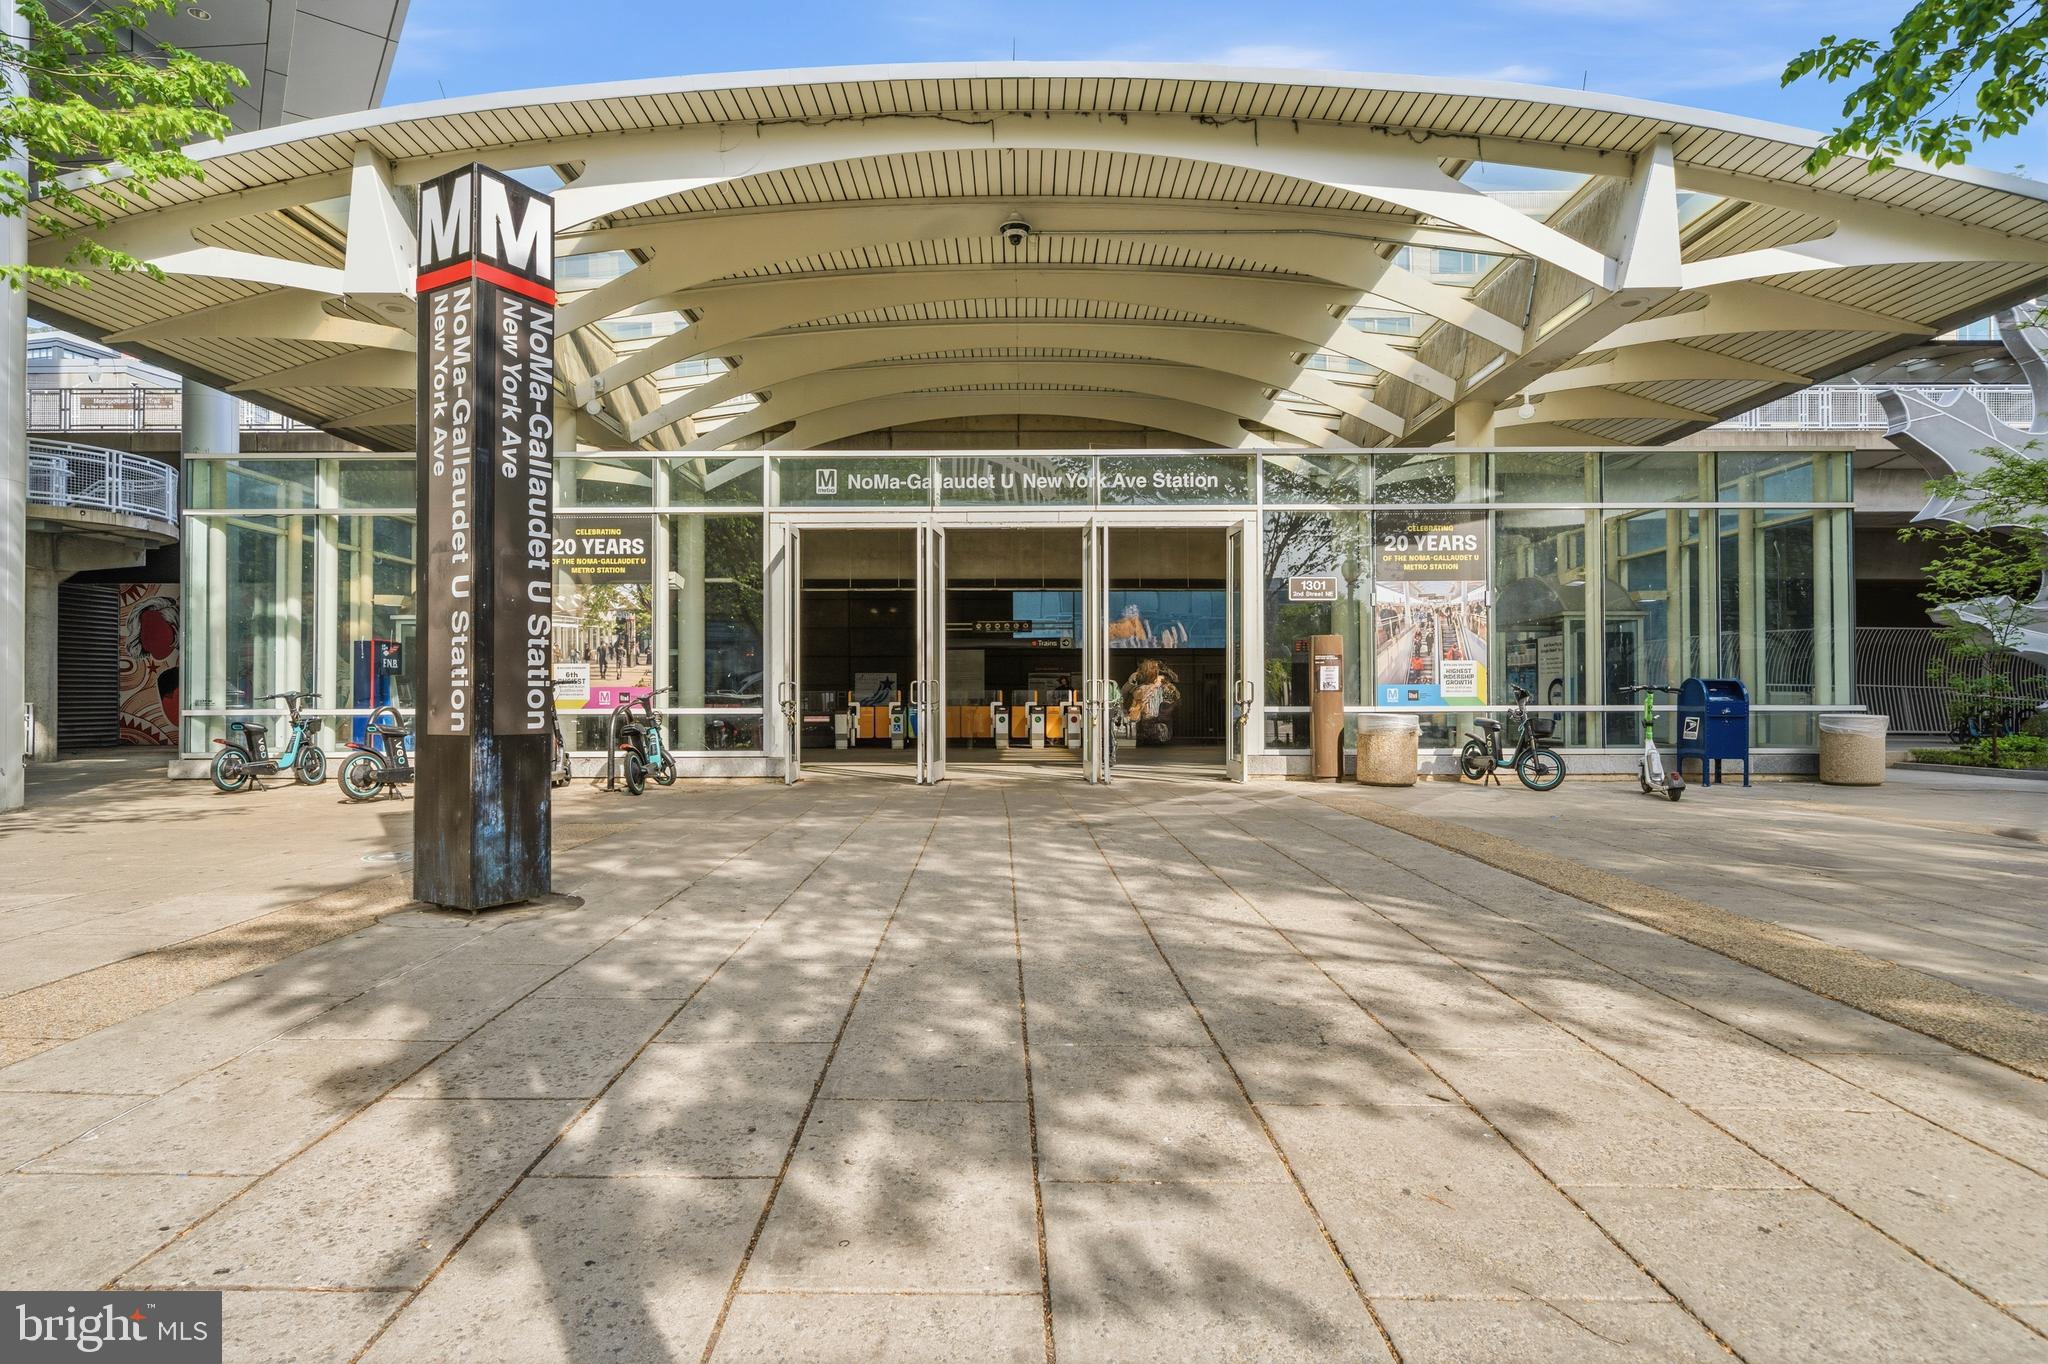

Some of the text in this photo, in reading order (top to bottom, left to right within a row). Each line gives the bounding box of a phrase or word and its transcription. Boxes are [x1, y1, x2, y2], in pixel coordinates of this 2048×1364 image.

[420, 172, 472, 267] M
[480, 173, 552, 281] M
[433, 293, 449, 477] New York Ave
[502, 297, 523, 479] New York Ave
[1001, 473, 1014, 489] U
[1023, 473, 1062, 489] New
[1066, 472, 1107, 488] York
[1113, 473, 1147, 488] Ave
[1152, 472, 1219, 488] Station
[451, 286, 471, 732] NoMa-Gallaudet U Station
[527, 306, 554, 730] NoMa-Gallaudet U Station
[575, 528, 622, 536] CELEBRATING
[1407, 524, 1454, 532] CELEBRATING
[553, 538, 645, 555] 20 YEARS
[1384, 534, 1478, 552] 20 YEARS
[1403, 563, 1428, 571] METRO
[1301, 580, 1326, 590] 1301
